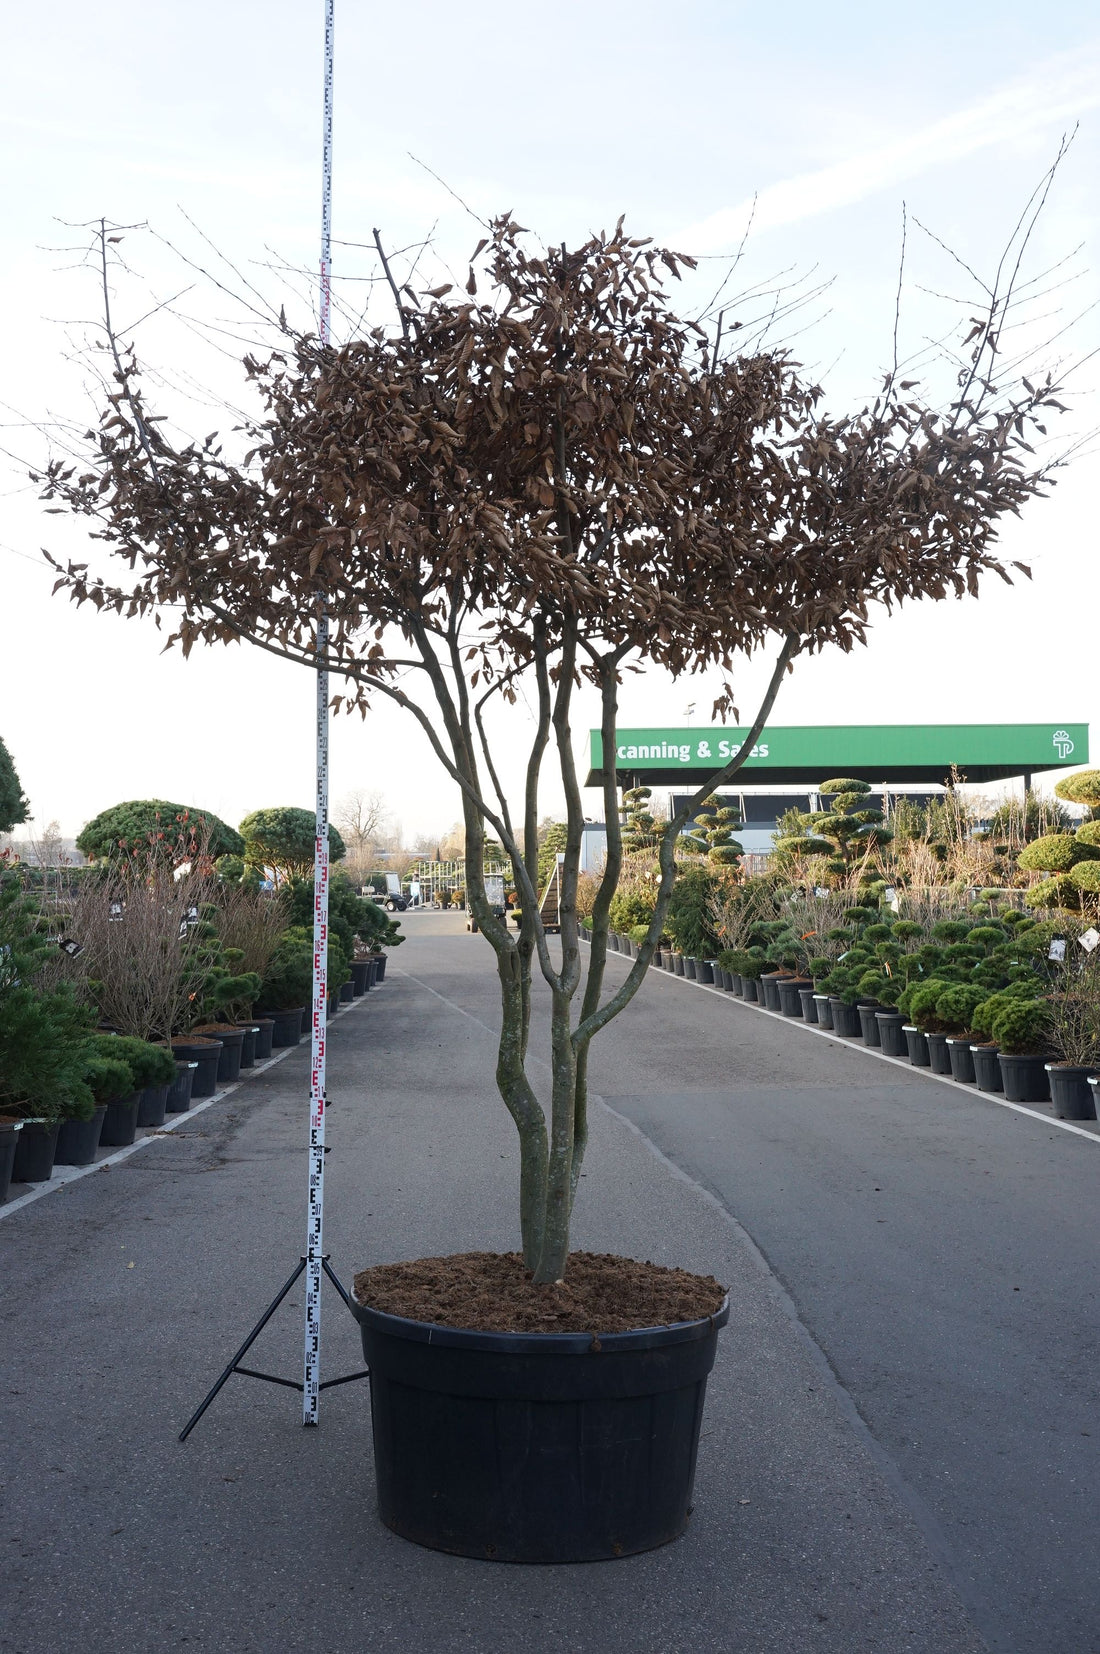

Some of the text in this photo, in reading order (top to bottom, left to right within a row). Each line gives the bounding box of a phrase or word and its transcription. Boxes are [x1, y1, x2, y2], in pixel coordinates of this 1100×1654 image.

[616, 740, 770, 762] canning & Saes
